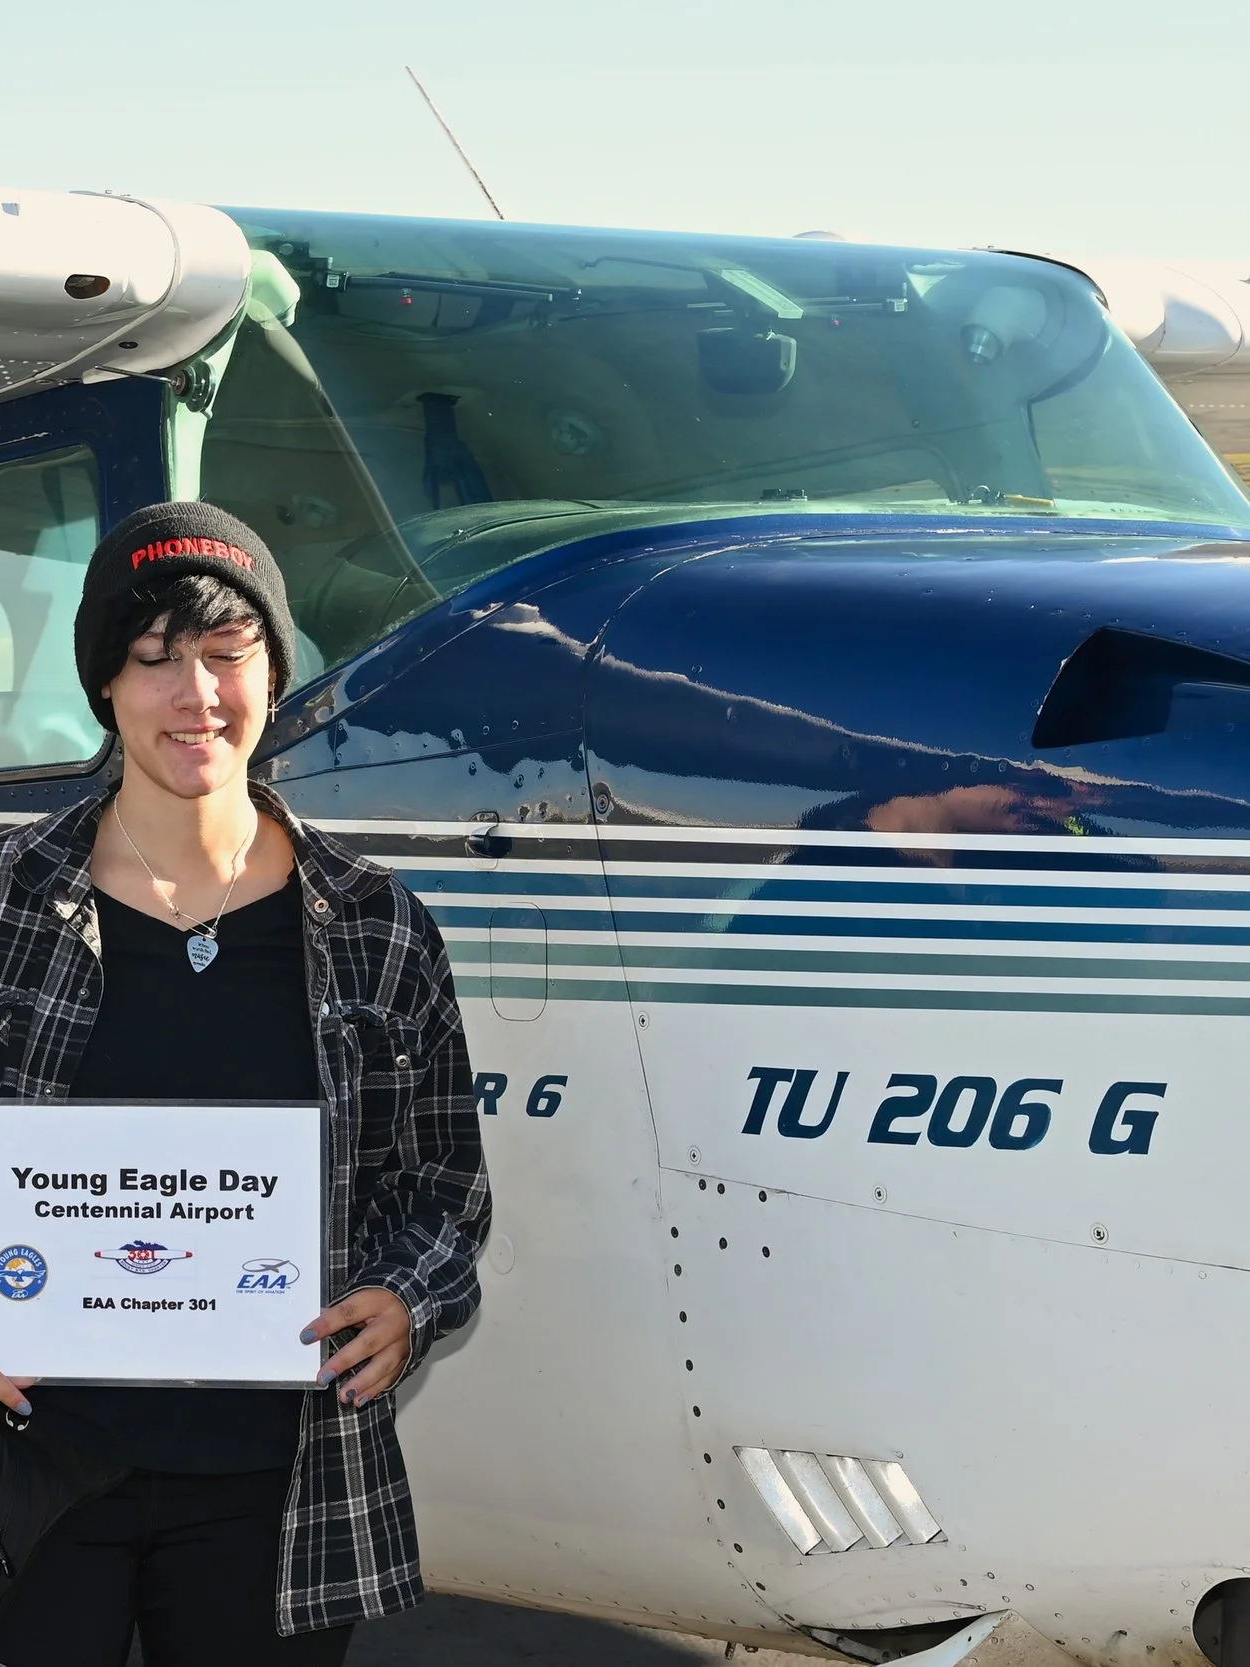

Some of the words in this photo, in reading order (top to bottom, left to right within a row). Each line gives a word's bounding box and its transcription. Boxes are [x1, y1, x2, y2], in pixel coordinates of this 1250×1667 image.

[473, 1072, 508, 1115] R
[526, 1075, 568, 1117] 6
[742, 1067, 850, 1139] TU
[867, 1074, 1063, 1150] 206
[1089, 1082, 1167, 1154] G
[11, 1167, 107, 1197] Young
[119, 1168, 207, 1197] Eagle
[219, 1169, 278, 1198] Day
[34, 1200, 161, 1219] Centennial
[170, 1202, 254, 1223] Airport
[21, 1249, 42, 1267] EAGLES
[237, 1274, 287, 1289] EAA
[83, 1297, 116, 1310] EAA
[120, 1298, 185, 1313] Chapter
[189, 1298, 216, 1311] 301
